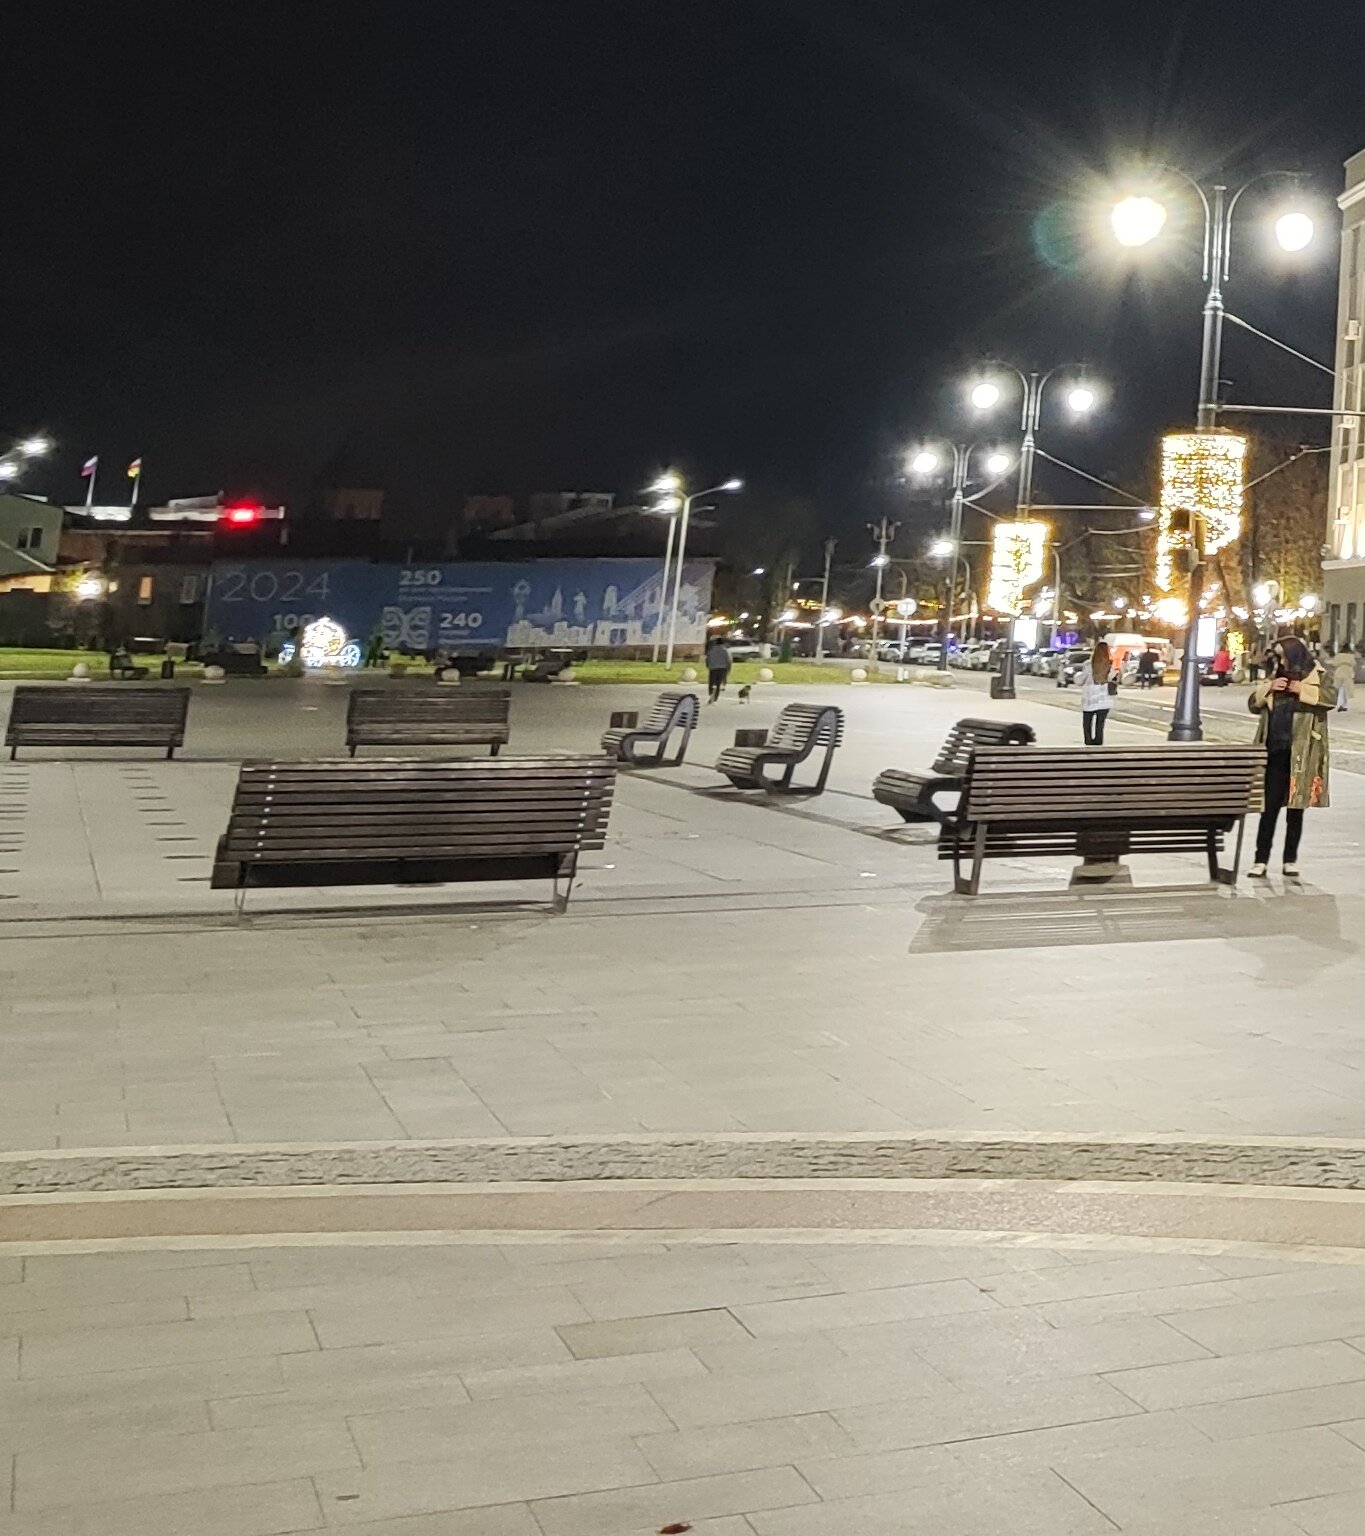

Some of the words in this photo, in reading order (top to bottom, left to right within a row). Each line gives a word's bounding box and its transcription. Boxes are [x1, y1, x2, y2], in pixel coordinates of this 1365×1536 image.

[399, 569, 442, 585] 250
[221, 571, 331, 602] 2024
[440, 612, 483, 628] 240
